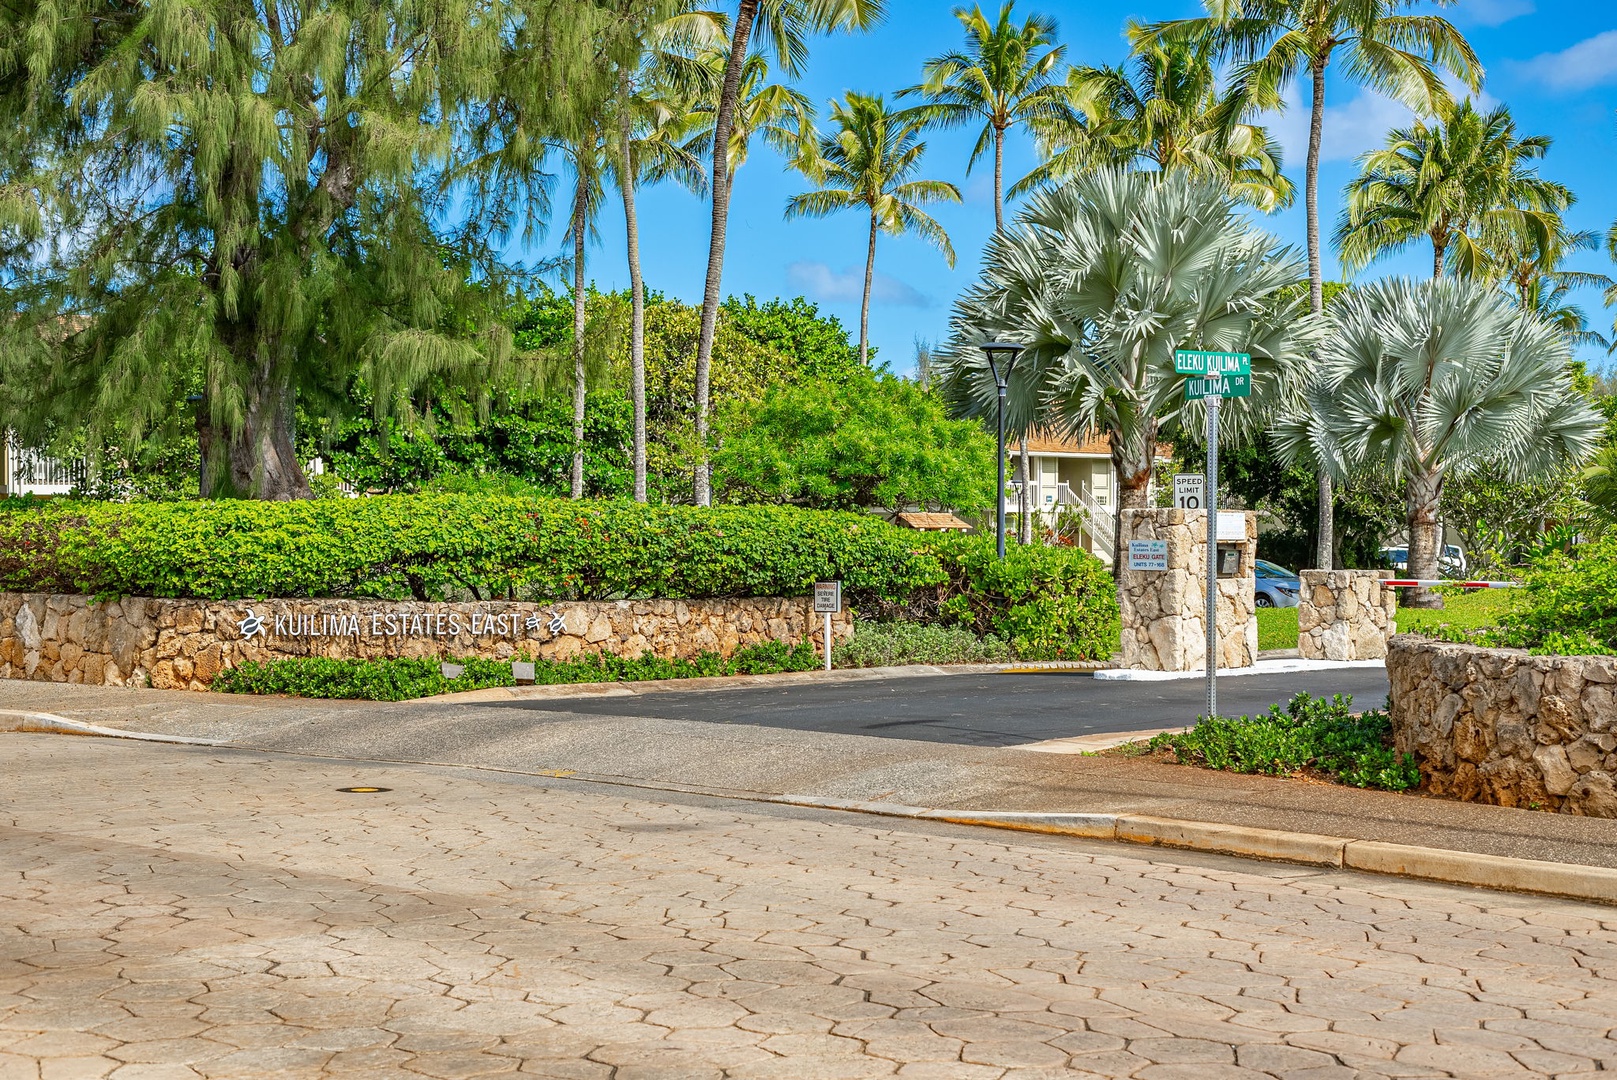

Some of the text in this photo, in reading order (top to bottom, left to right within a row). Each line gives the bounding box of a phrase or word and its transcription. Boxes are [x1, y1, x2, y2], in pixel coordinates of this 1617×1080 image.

[1177, 354, 1248, 372] ELEKU KUILIMA PL
[1188, 377, 1244, 396] KUILIMA DR
[1179, 495, 1199, 509] 10
[275, 613, 521, 636] KUILIMA ESTATES EAST
